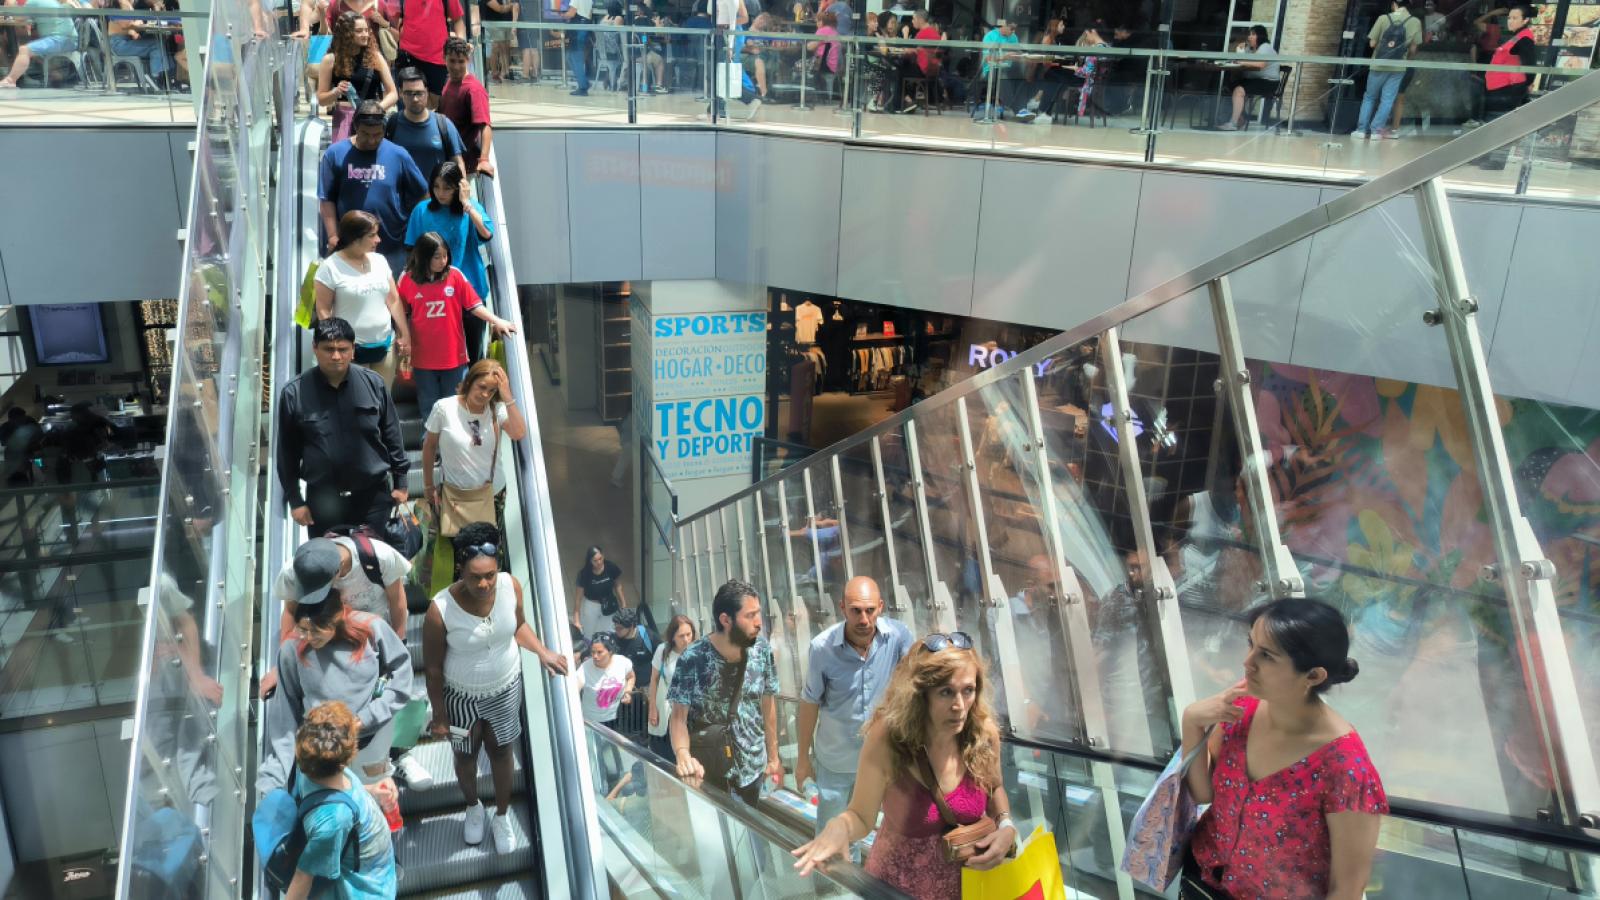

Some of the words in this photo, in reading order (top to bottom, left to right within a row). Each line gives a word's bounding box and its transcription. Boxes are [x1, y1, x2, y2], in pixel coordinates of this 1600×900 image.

[426, 300, 446, 318] 22
[655, 313, 765, 337] SPORTS
[655, 357, 712, 379] HOGAR
[724, 353, 765, 375] DECO
[655, 396, 763, 437] TECNO
[656, 439, 671, 461] Y
